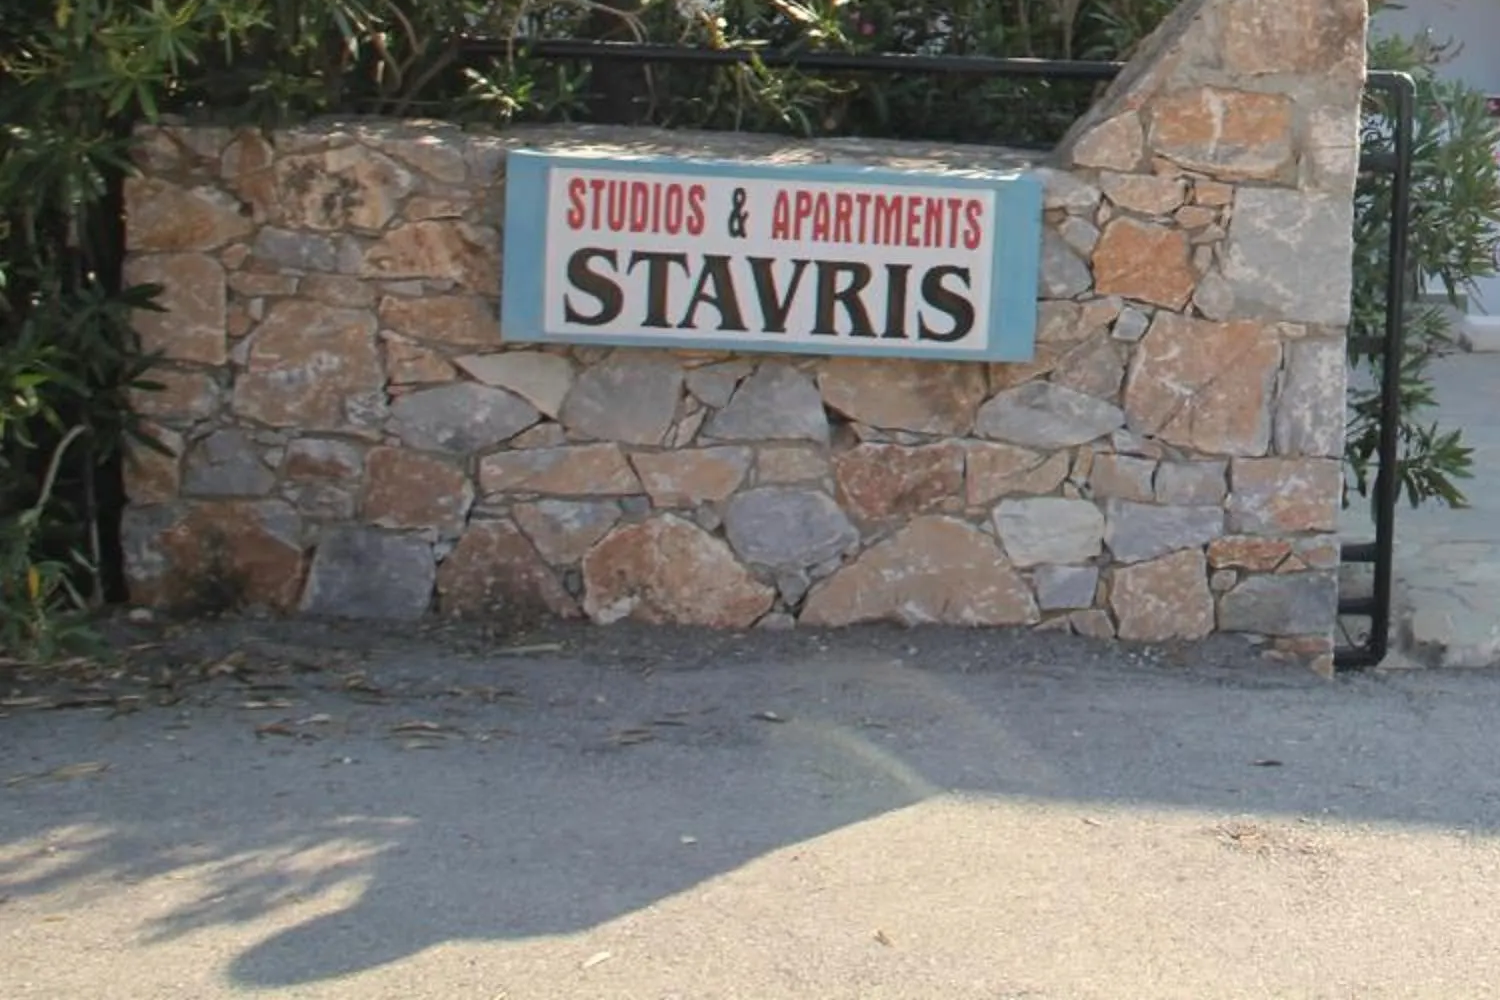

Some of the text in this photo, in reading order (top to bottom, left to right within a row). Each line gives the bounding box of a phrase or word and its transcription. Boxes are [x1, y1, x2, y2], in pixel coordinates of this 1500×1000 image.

[567, 177, 983, 250] STUDIOS & APARTMENTS
[563, 246, 976, 343] STAVRIS
